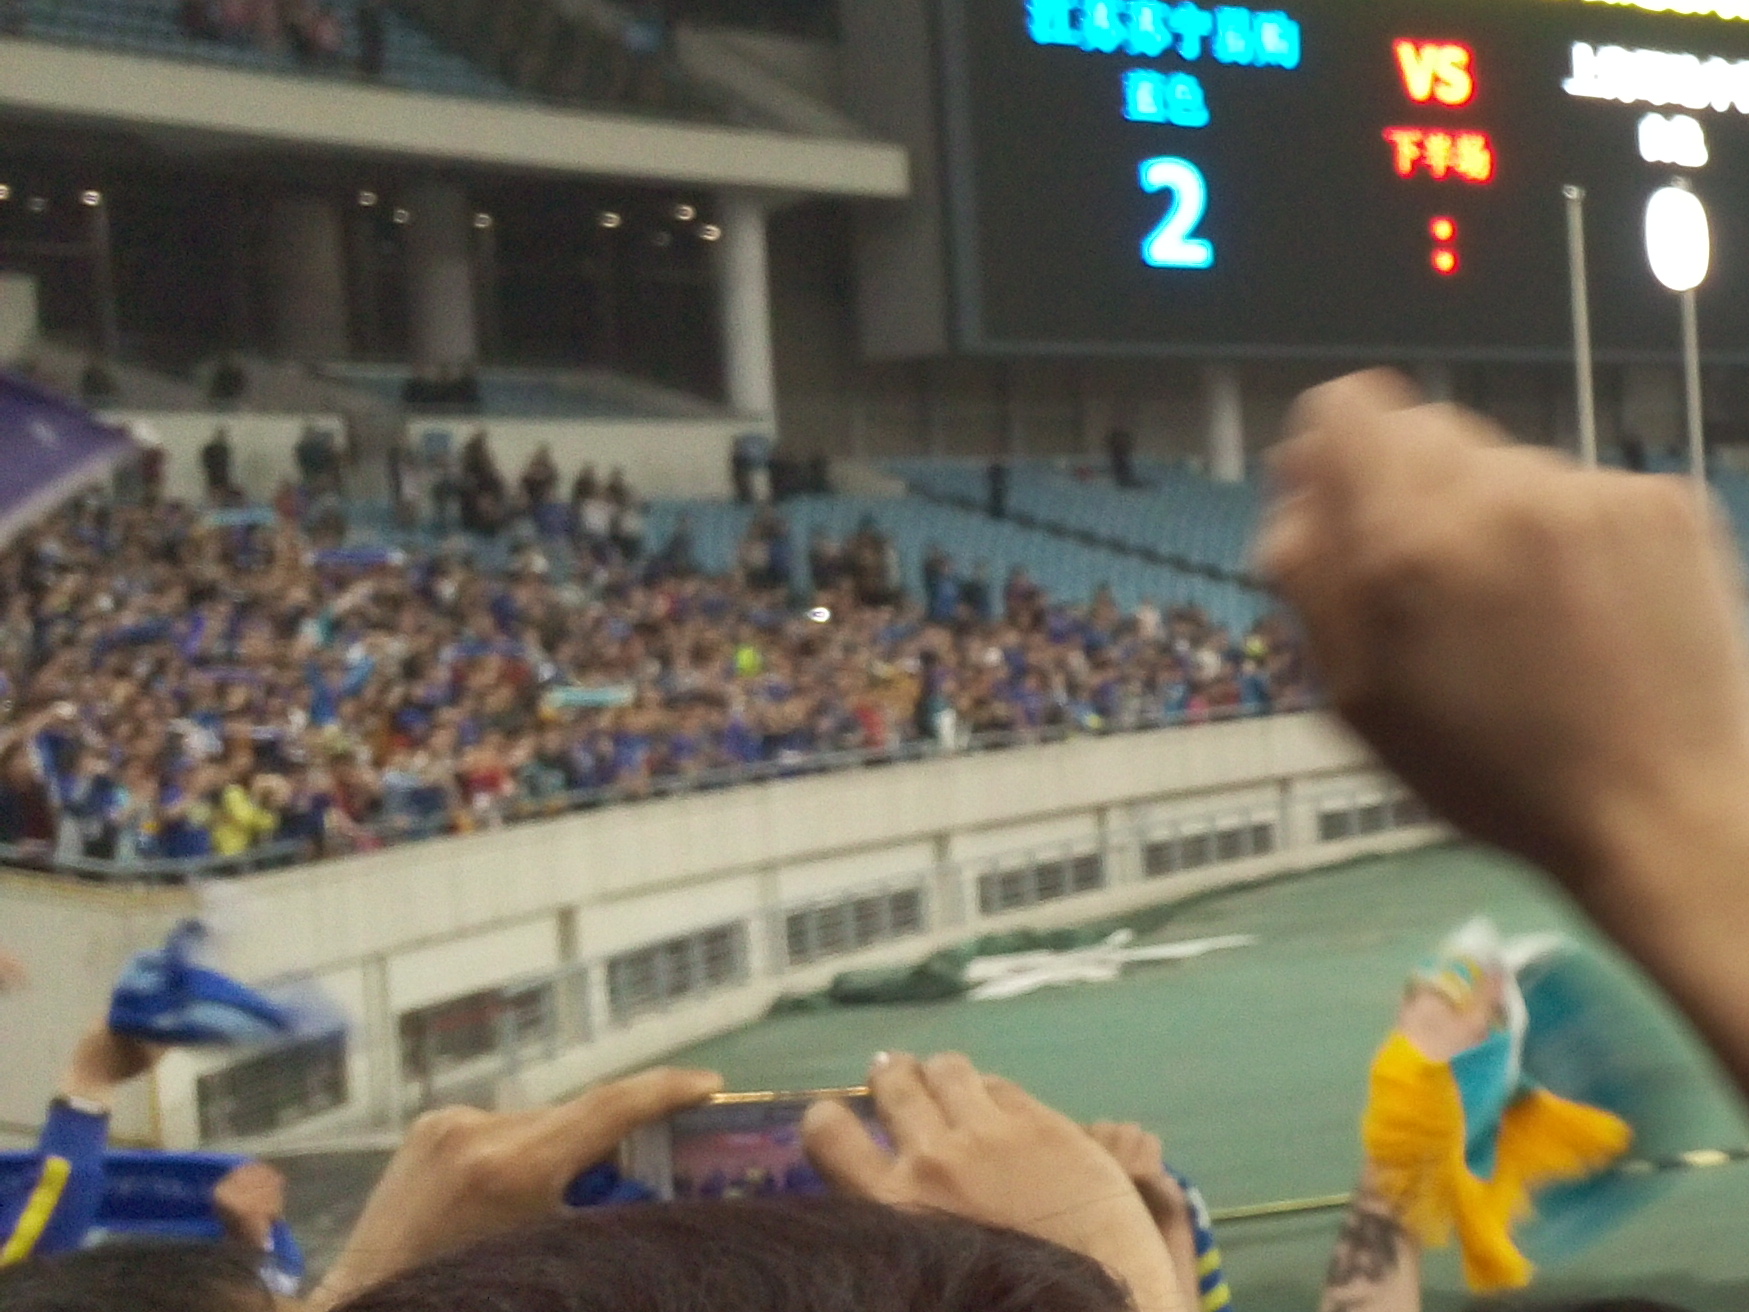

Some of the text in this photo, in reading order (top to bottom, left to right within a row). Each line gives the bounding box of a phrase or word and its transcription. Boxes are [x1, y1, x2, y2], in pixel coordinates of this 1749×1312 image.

[1393, 39, 1475, 107] VS
[1382, 125, 1495, 183] 下半场
[1138, 154, 1215, 268] 2
